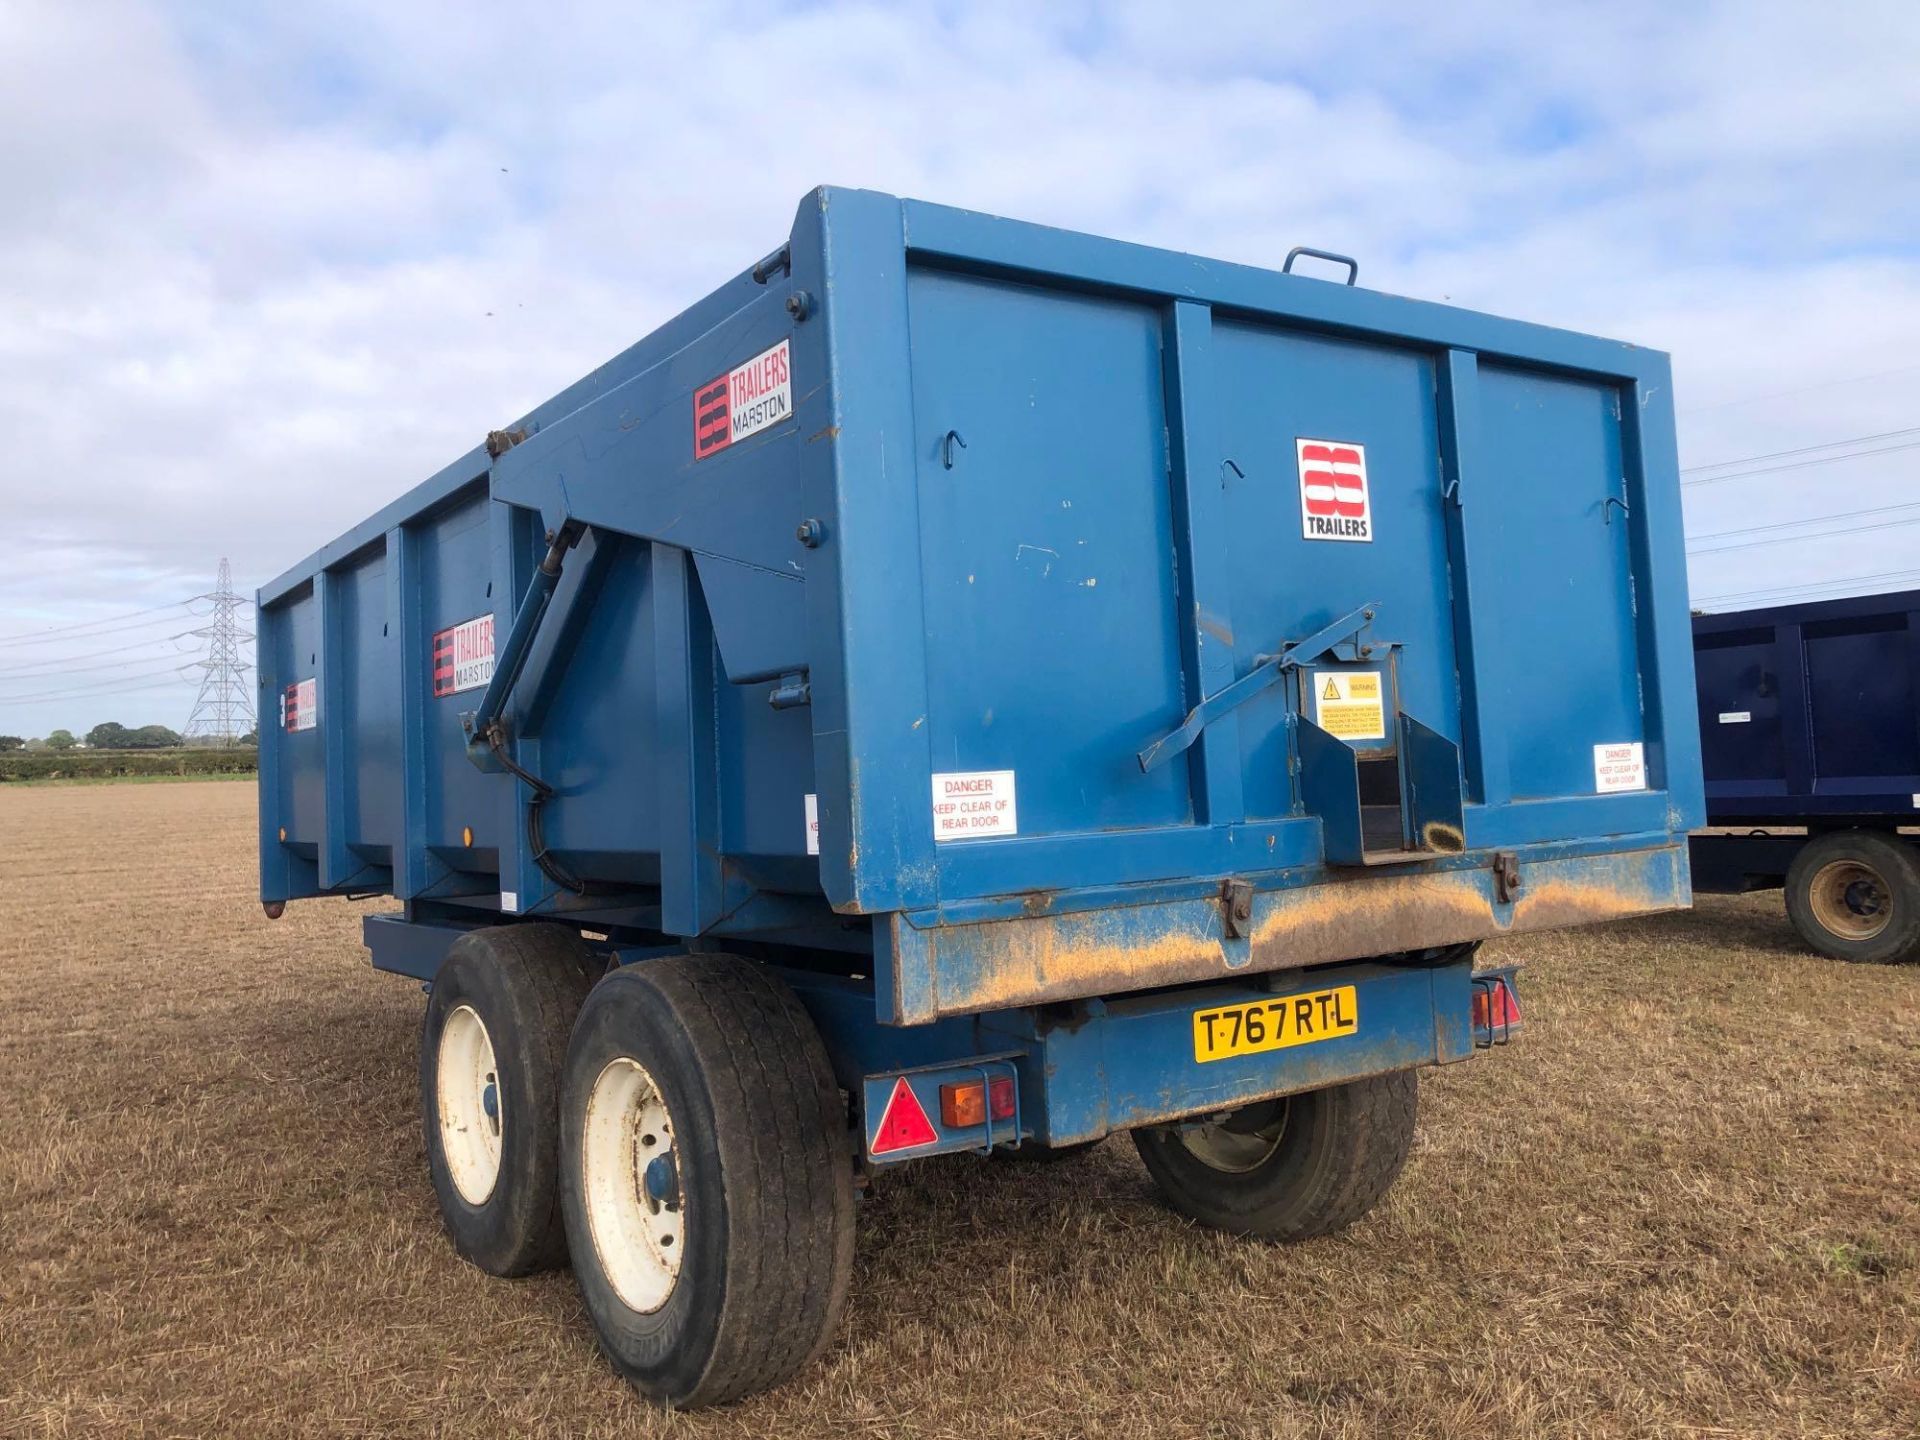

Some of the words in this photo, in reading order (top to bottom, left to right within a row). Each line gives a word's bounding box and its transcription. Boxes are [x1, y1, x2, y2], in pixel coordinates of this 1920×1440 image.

[732, 347, 788, 408] TRAILERS
[733, 392, 785, 435] MARSTON
[1307, 517, 1368, 537] TRAILERS
[945, 779, 993, 793] DANGER
[933, 803, 956, 815] KEEP
[960, 801, 992, 813] CLEAR
[994, 800, 1008, 811] OF
[942, 818, 968, 829] REAR
[971, 816, 999, 828] DOOR
[1200, 1002, 1287, 1052] T767
[1295, 993, 1353, 1036] RTL
